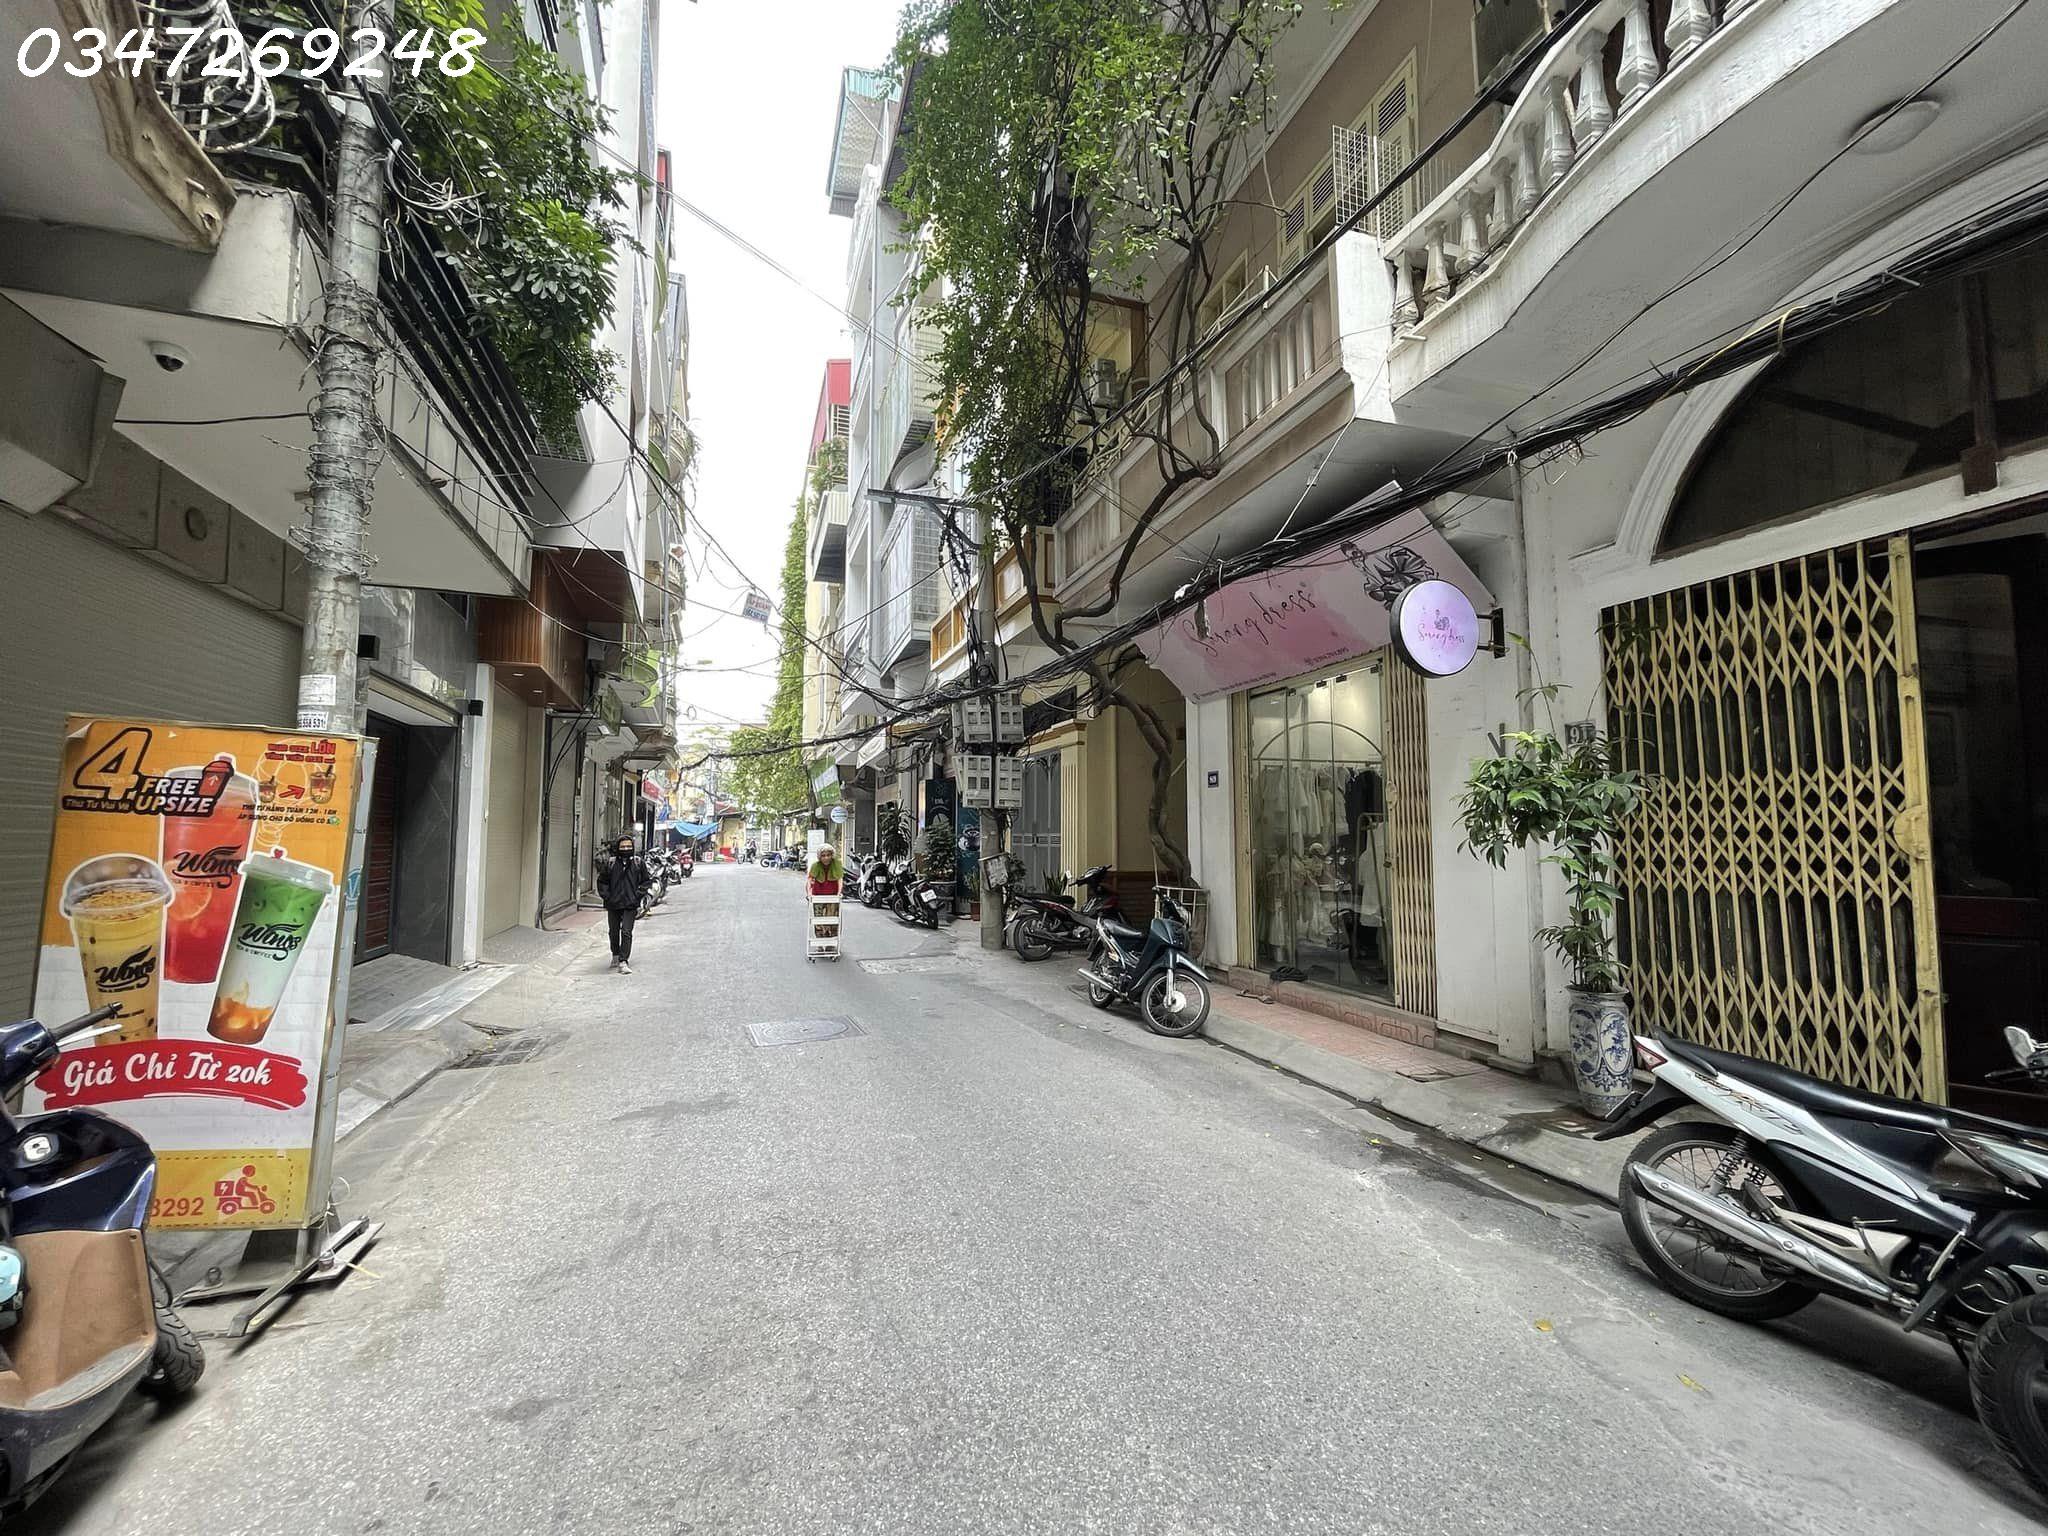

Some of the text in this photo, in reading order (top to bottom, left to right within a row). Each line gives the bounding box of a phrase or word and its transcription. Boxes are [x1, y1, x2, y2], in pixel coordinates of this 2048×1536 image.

[73, 727, 152, 801] 4
[141, 779, 200, 795] FREE
[136, 795, 214, 812] UPSIZE
[64, 1051, 273, 1096] Giá Chỉ Từ 20k
